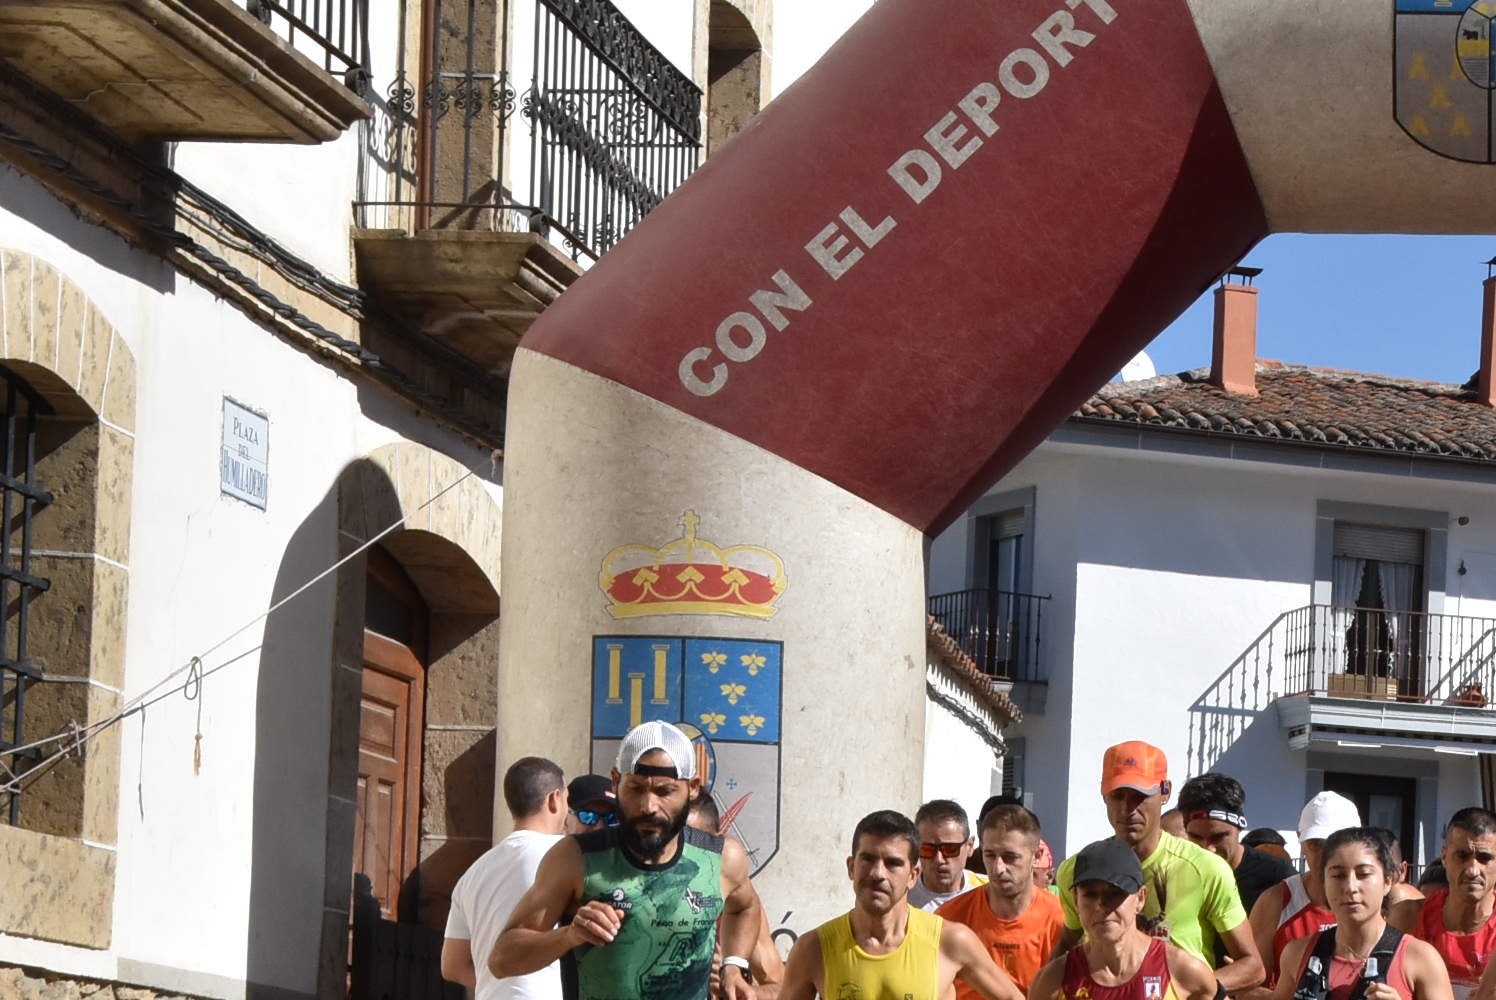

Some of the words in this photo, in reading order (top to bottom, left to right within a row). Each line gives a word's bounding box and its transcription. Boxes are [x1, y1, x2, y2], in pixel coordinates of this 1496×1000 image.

[677, 270, 814, 398] CON
[804, 205, 898, 281] EL
[233, 417, 259, 446] PLAZA
[238, 443, 250, 461] DEL
[223, 449, 266, 500] HUMILLADERO
